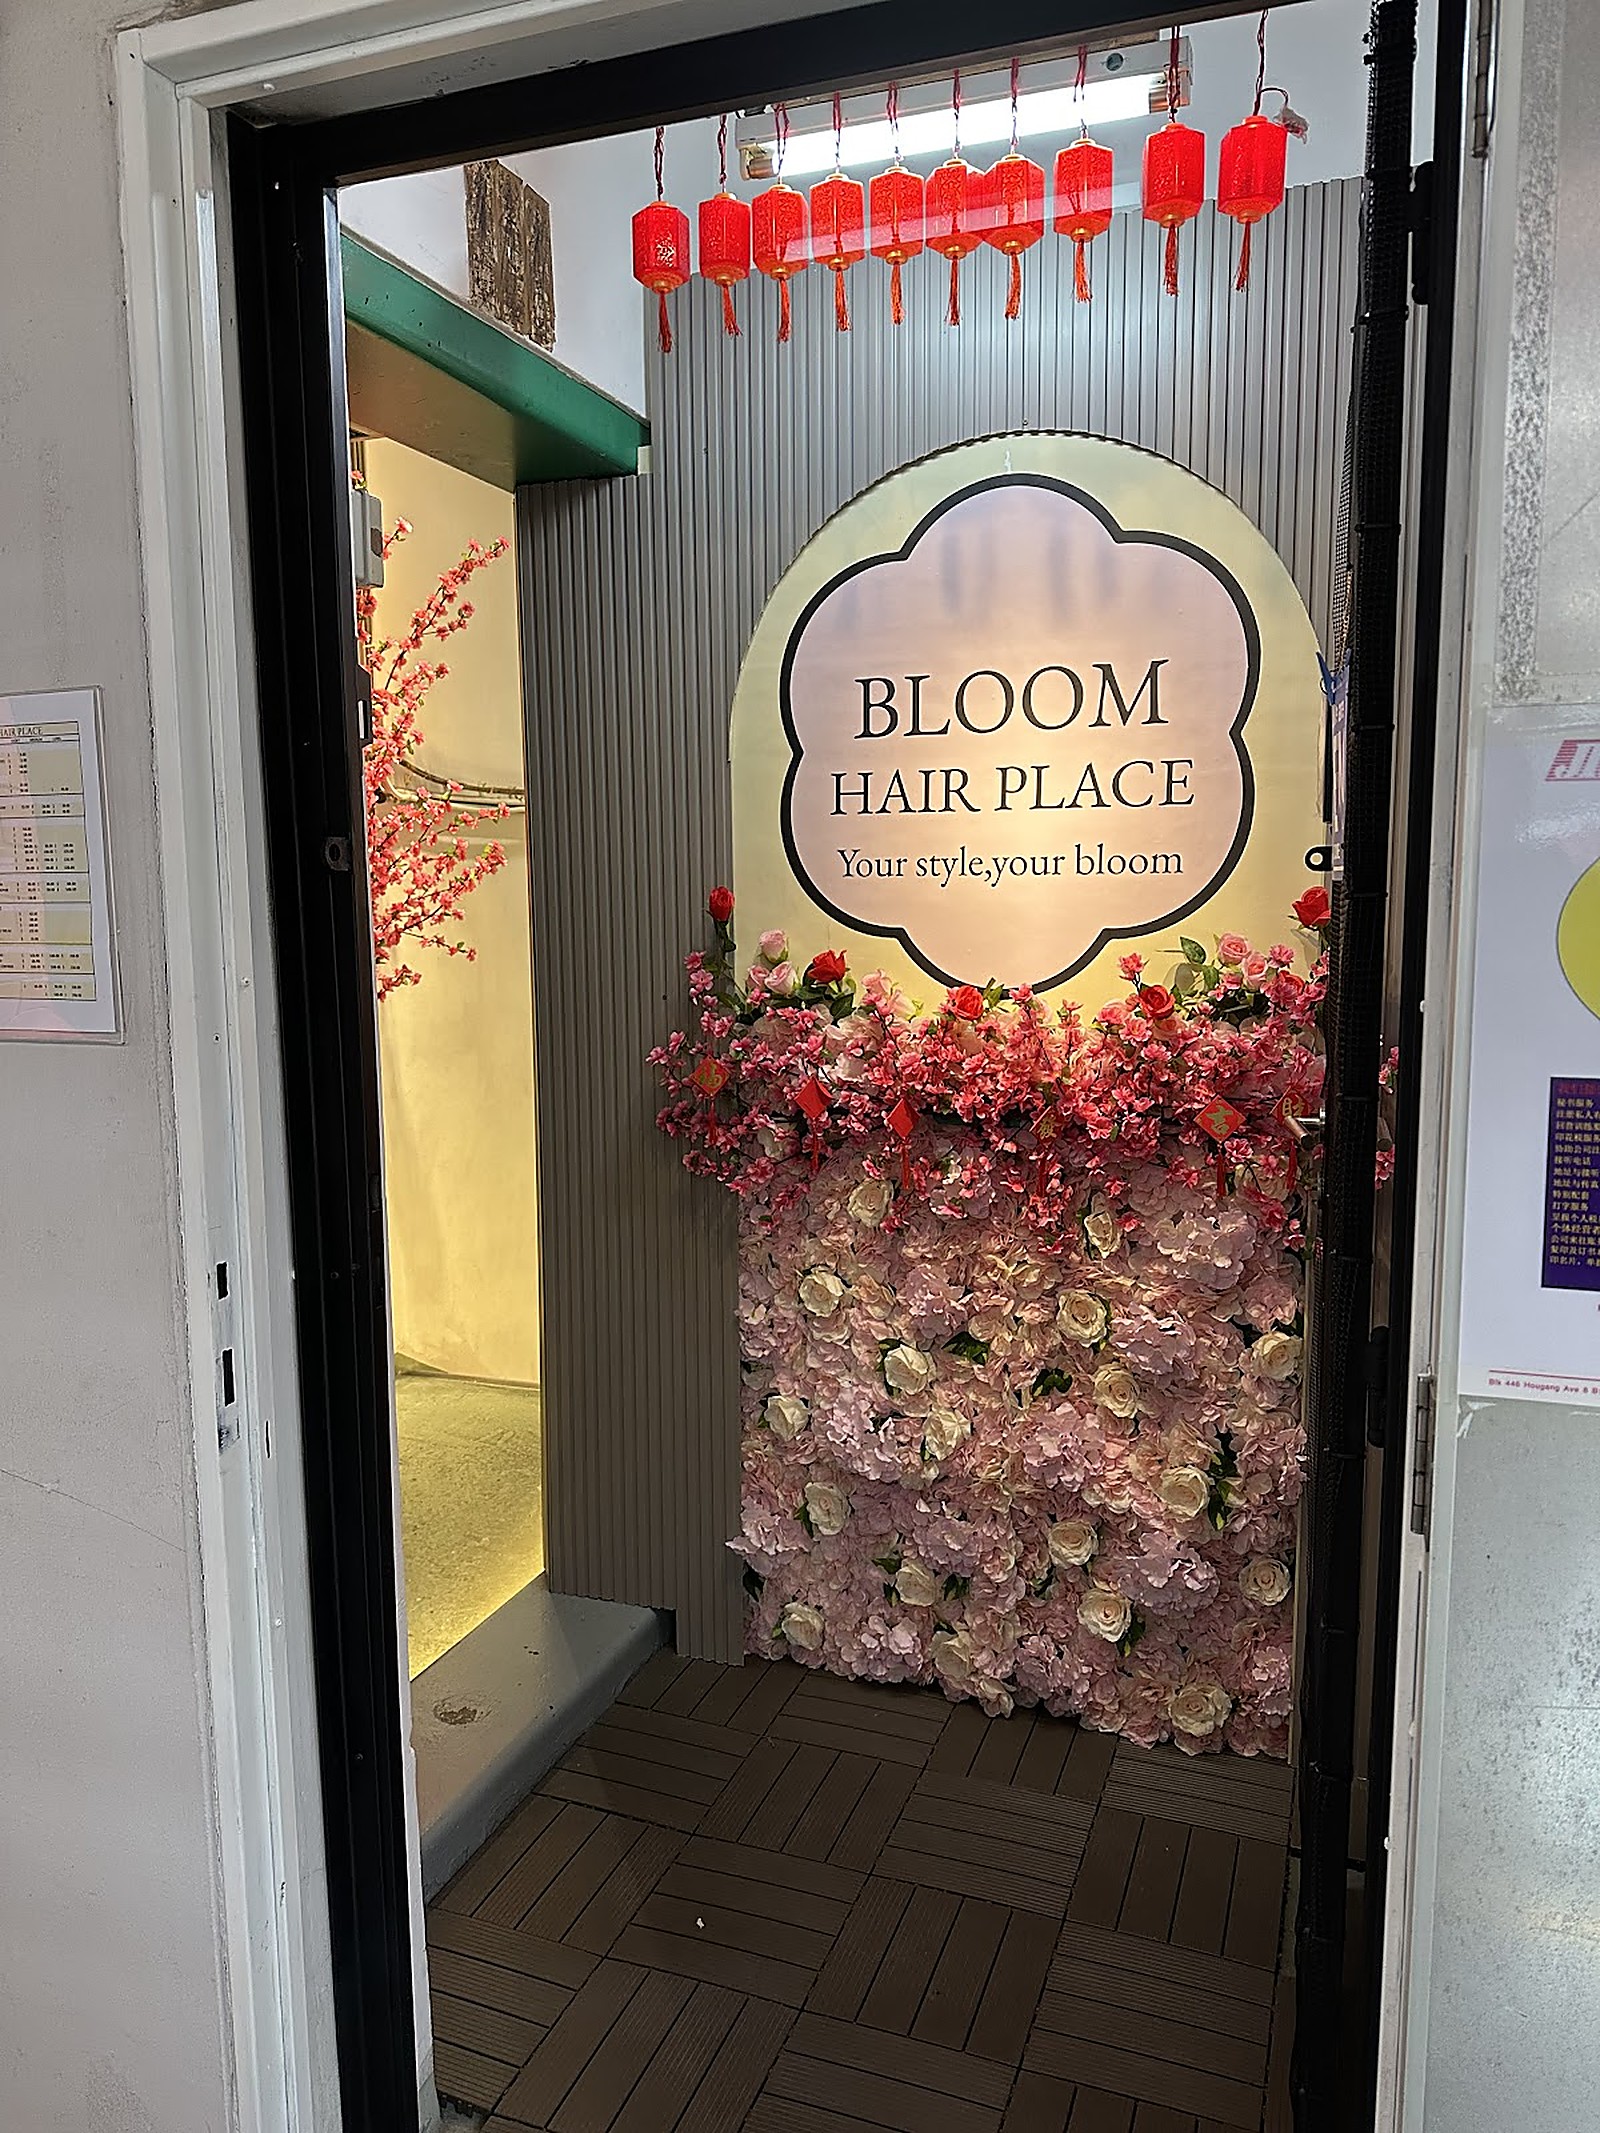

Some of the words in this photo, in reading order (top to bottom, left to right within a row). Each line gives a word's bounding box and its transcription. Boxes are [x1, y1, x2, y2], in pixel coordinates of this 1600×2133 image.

[853, 659, 1169, 739] BLOOM
[18, 726, 43, 737] PLACE
[830, 768, 981, 816] HAIR
[994, 759, 1195, 811] PLACE
[837, 849, 907, 878] Your
[915, 846, 1065, 887] style,your
[1075, 843, 1184, 876] bloom
[1488, 1378, 1501, 1386] Blk
[1523, 1381, 1560, 1391] Hougang
